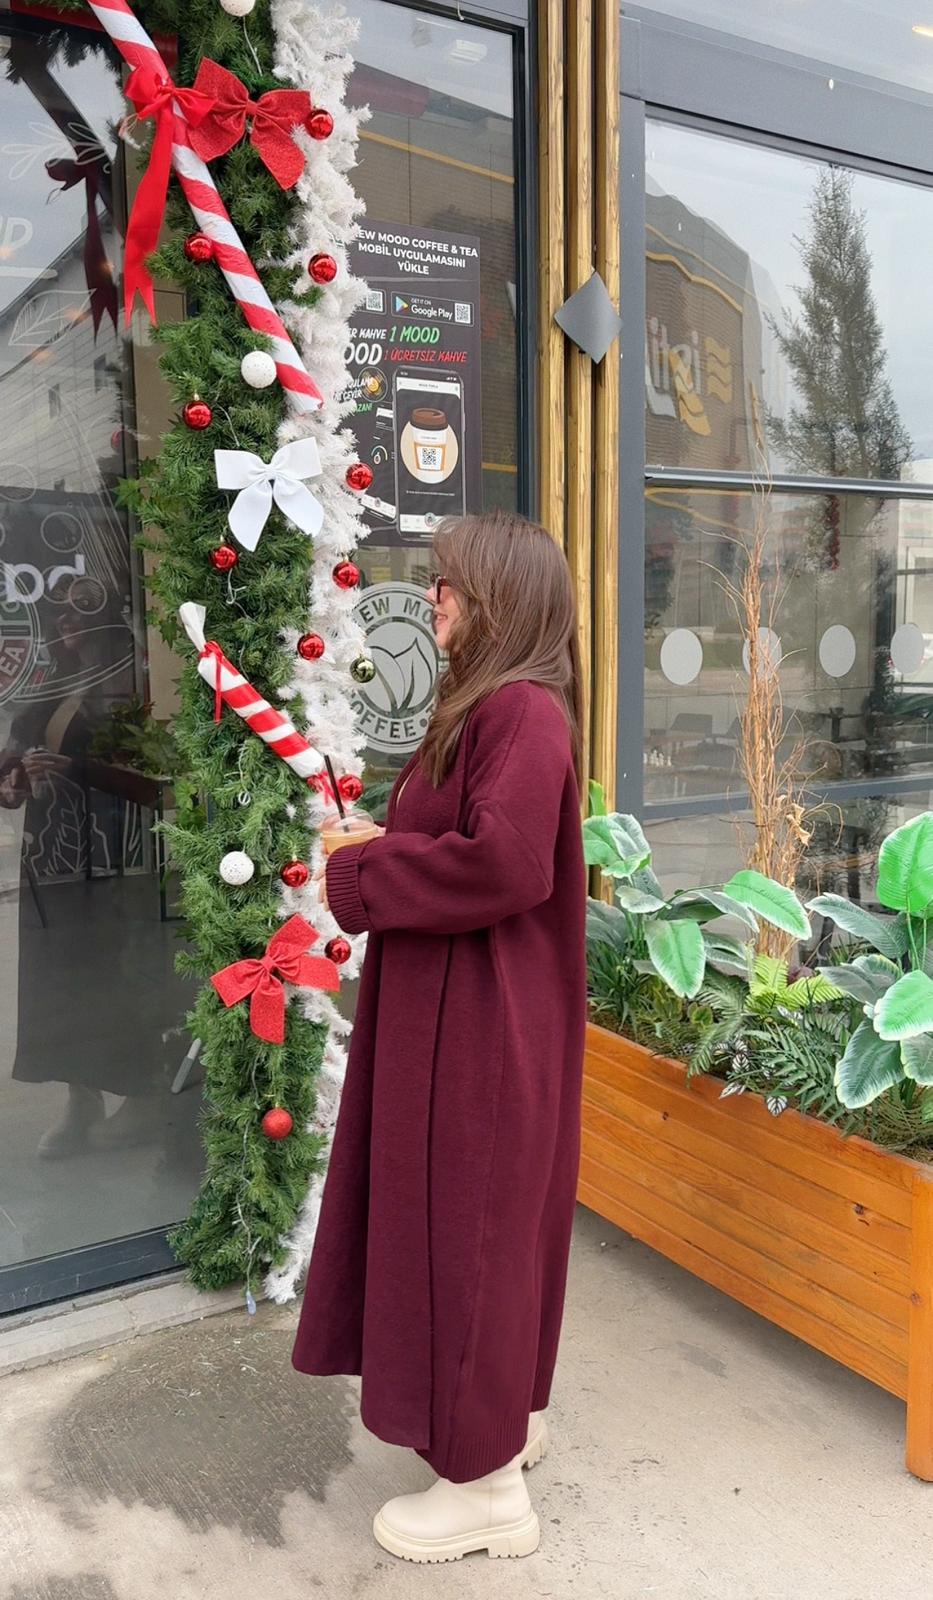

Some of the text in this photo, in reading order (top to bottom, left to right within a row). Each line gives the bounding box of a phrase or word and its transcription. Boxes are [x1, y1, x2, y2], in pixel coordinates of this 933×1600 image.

[355, 229, 479, 258] EW MOOD COFFEE & TEA
[358, 242, 466, 268] MOBİL UYGULAMASINI
[397, 260, 430, 275] YÜKLE
[411, 304, 453, 321] Google Play
[359, 328, 387, 341] KAHVE
[389, 326, 398, 342] 1
[400, 326, 440, 344] MOOD
[344, 341, 383, 366] OOD
[390, 347, 437, 362] ÜCRETSİZ
[438, 351, 468, 363] KAHVE
[358, 597, 390, 623] EW
[351, 699, 417, 740] OFFEE
